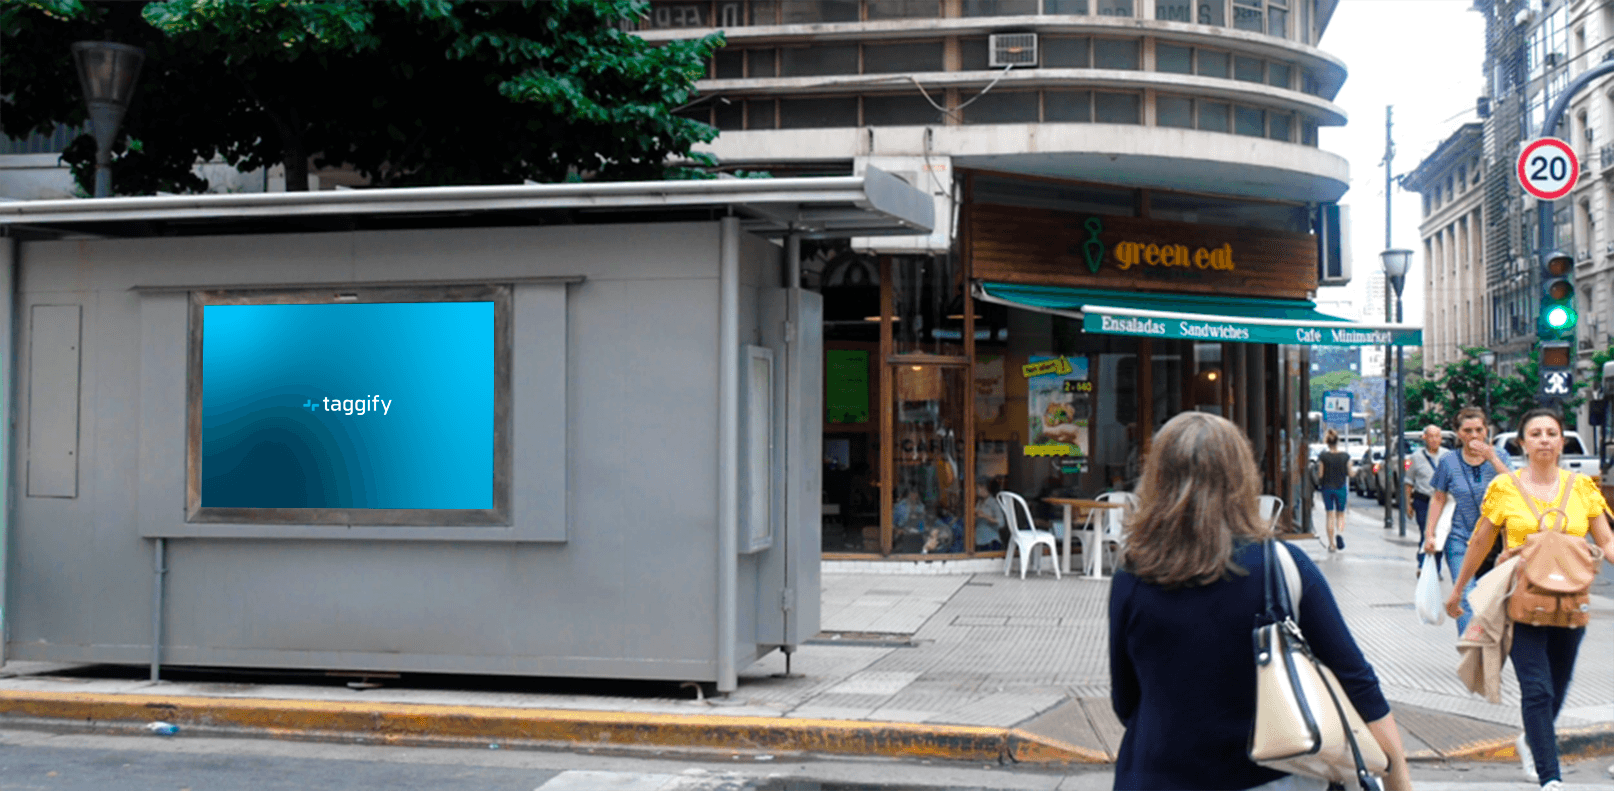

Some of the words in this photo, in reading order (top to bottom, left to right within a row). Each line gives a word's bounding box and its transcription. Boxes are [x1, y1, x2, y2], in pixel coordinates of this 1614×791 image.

[1531, 156, 1567, 181] 20
[1115, 241, 1191, 270] green
[1195, 242, 1235, 270] eat
[1101, 315, 1166, 334] Ensaladas
[1179, 321, 1250, 339] Sandwiches
[1296, 328, 1322, 342] Café
[1331, 328, 1392, 344] Minimarket
[323, 394, 392, 416] taggify
